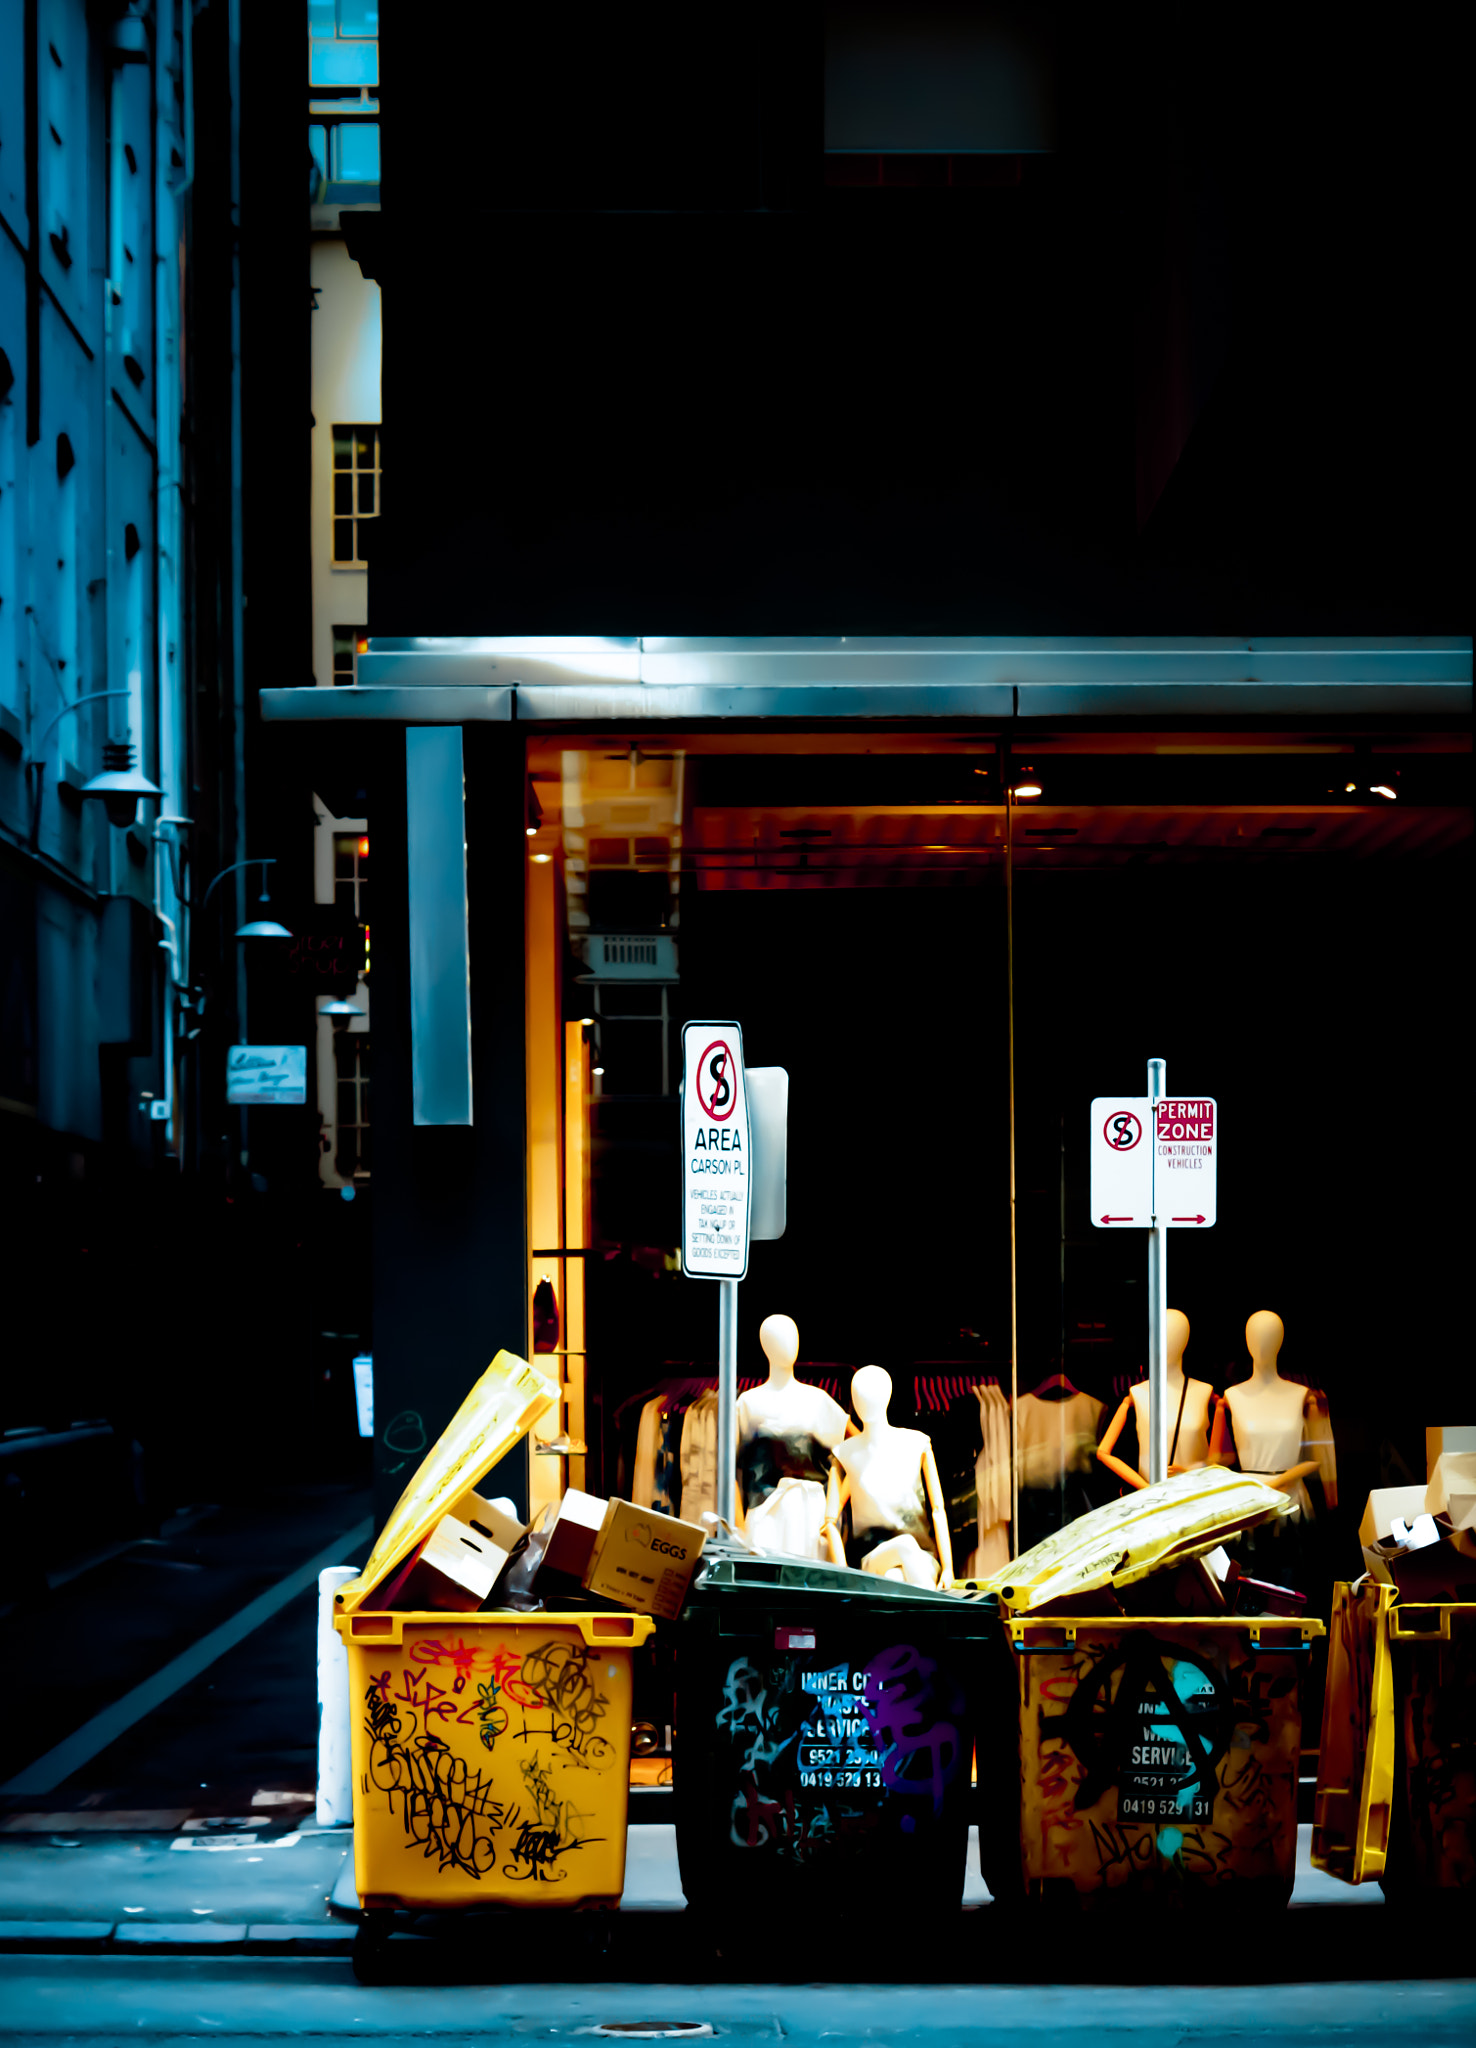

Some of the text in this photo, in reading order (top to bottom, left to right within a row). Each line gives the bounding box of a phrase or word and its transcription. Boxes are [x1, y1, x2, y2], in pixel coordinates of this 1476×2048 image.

[1158, 1102, 1212, 1119] PERMIT
[694, 1127, 742, 1151] AREA
[1158, 1123, 1213, 1140] ZONE
[1157, 1145, 1213, 1156] CONSTRUCTION
[691, 1158, 745, 1176] CARSON PL
[1167, 1158, 1203, 1169] VEHICLES
[650, 1538, 687, 1561] EGGS
[1131, 1745, 1195, 1767] SERVICE
[800, 1771, 833, 1788] 0419
[1122, 1798, 1156, 1814] 0419
[1159, 1800, 1183, 1816] 529
